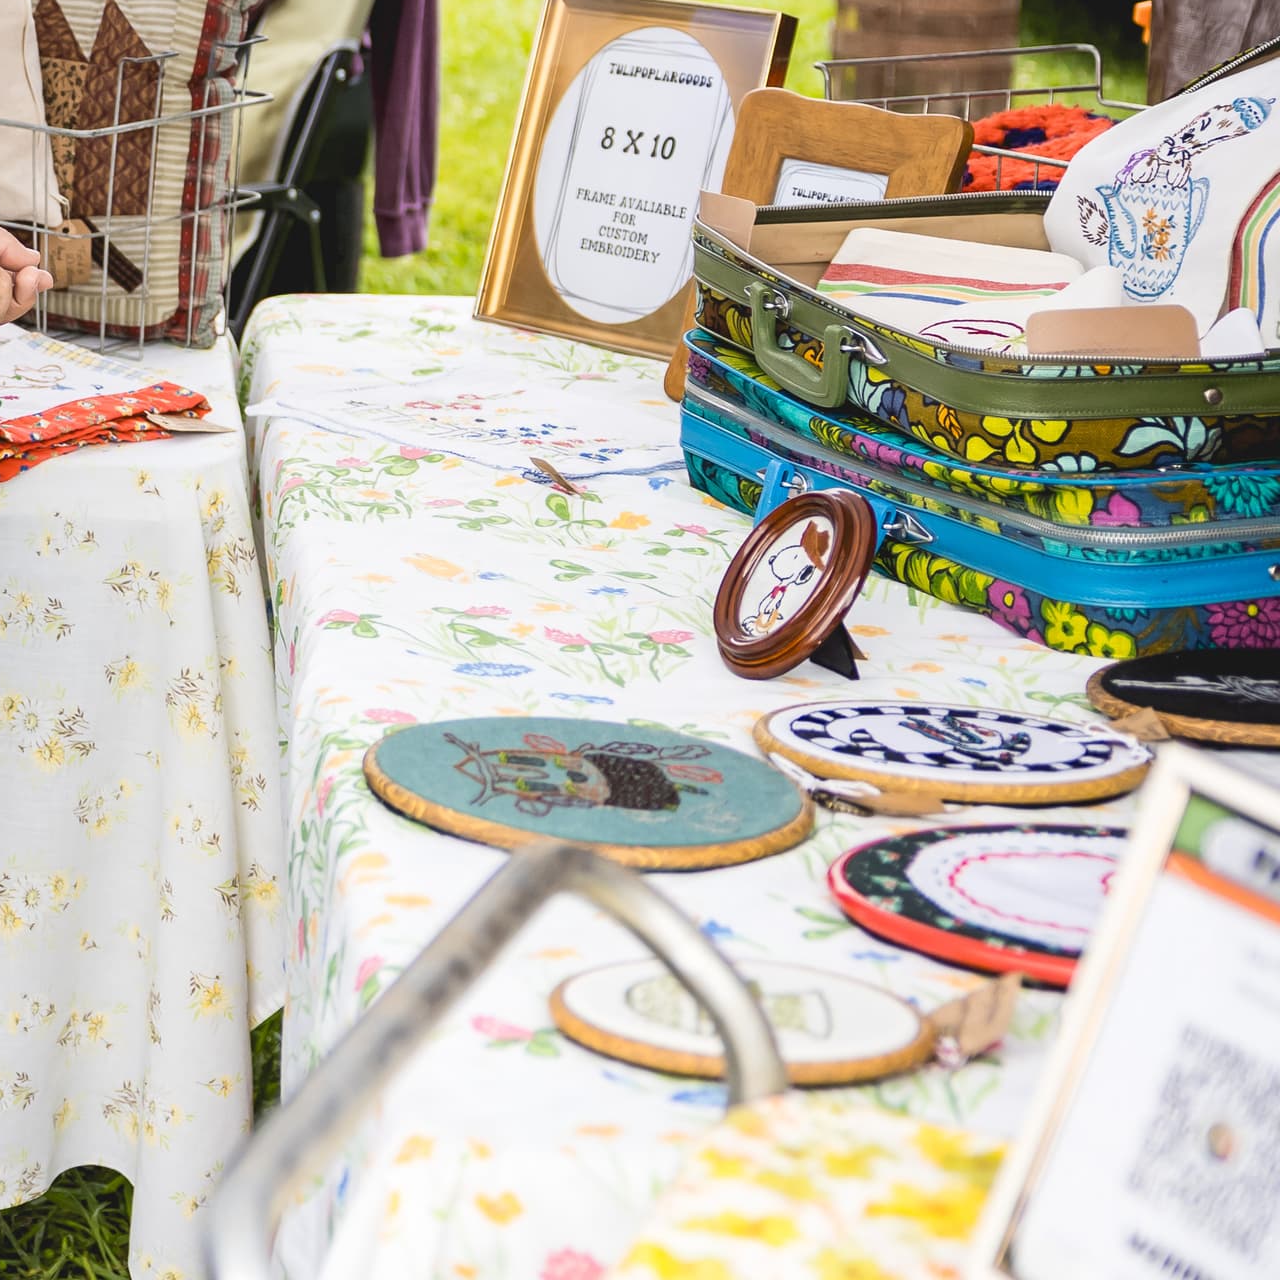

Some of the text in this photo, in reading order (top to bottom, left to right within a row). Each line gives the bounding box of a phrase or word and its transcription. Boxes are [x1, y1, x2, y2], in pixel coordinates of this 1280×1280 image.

[609, 62, 715, 88] TULIPOPLARGOODS
[600, 126, 616, 150] 8
[650, 133, 677, 160] 10
[576, 187, 689, 220] FRAME AVALIABLE
[612, 211, 637, 227] FOR
[598, 225, 649, 246] CUSTOM
[579, 238, 662, 264] EMBROIDERY
